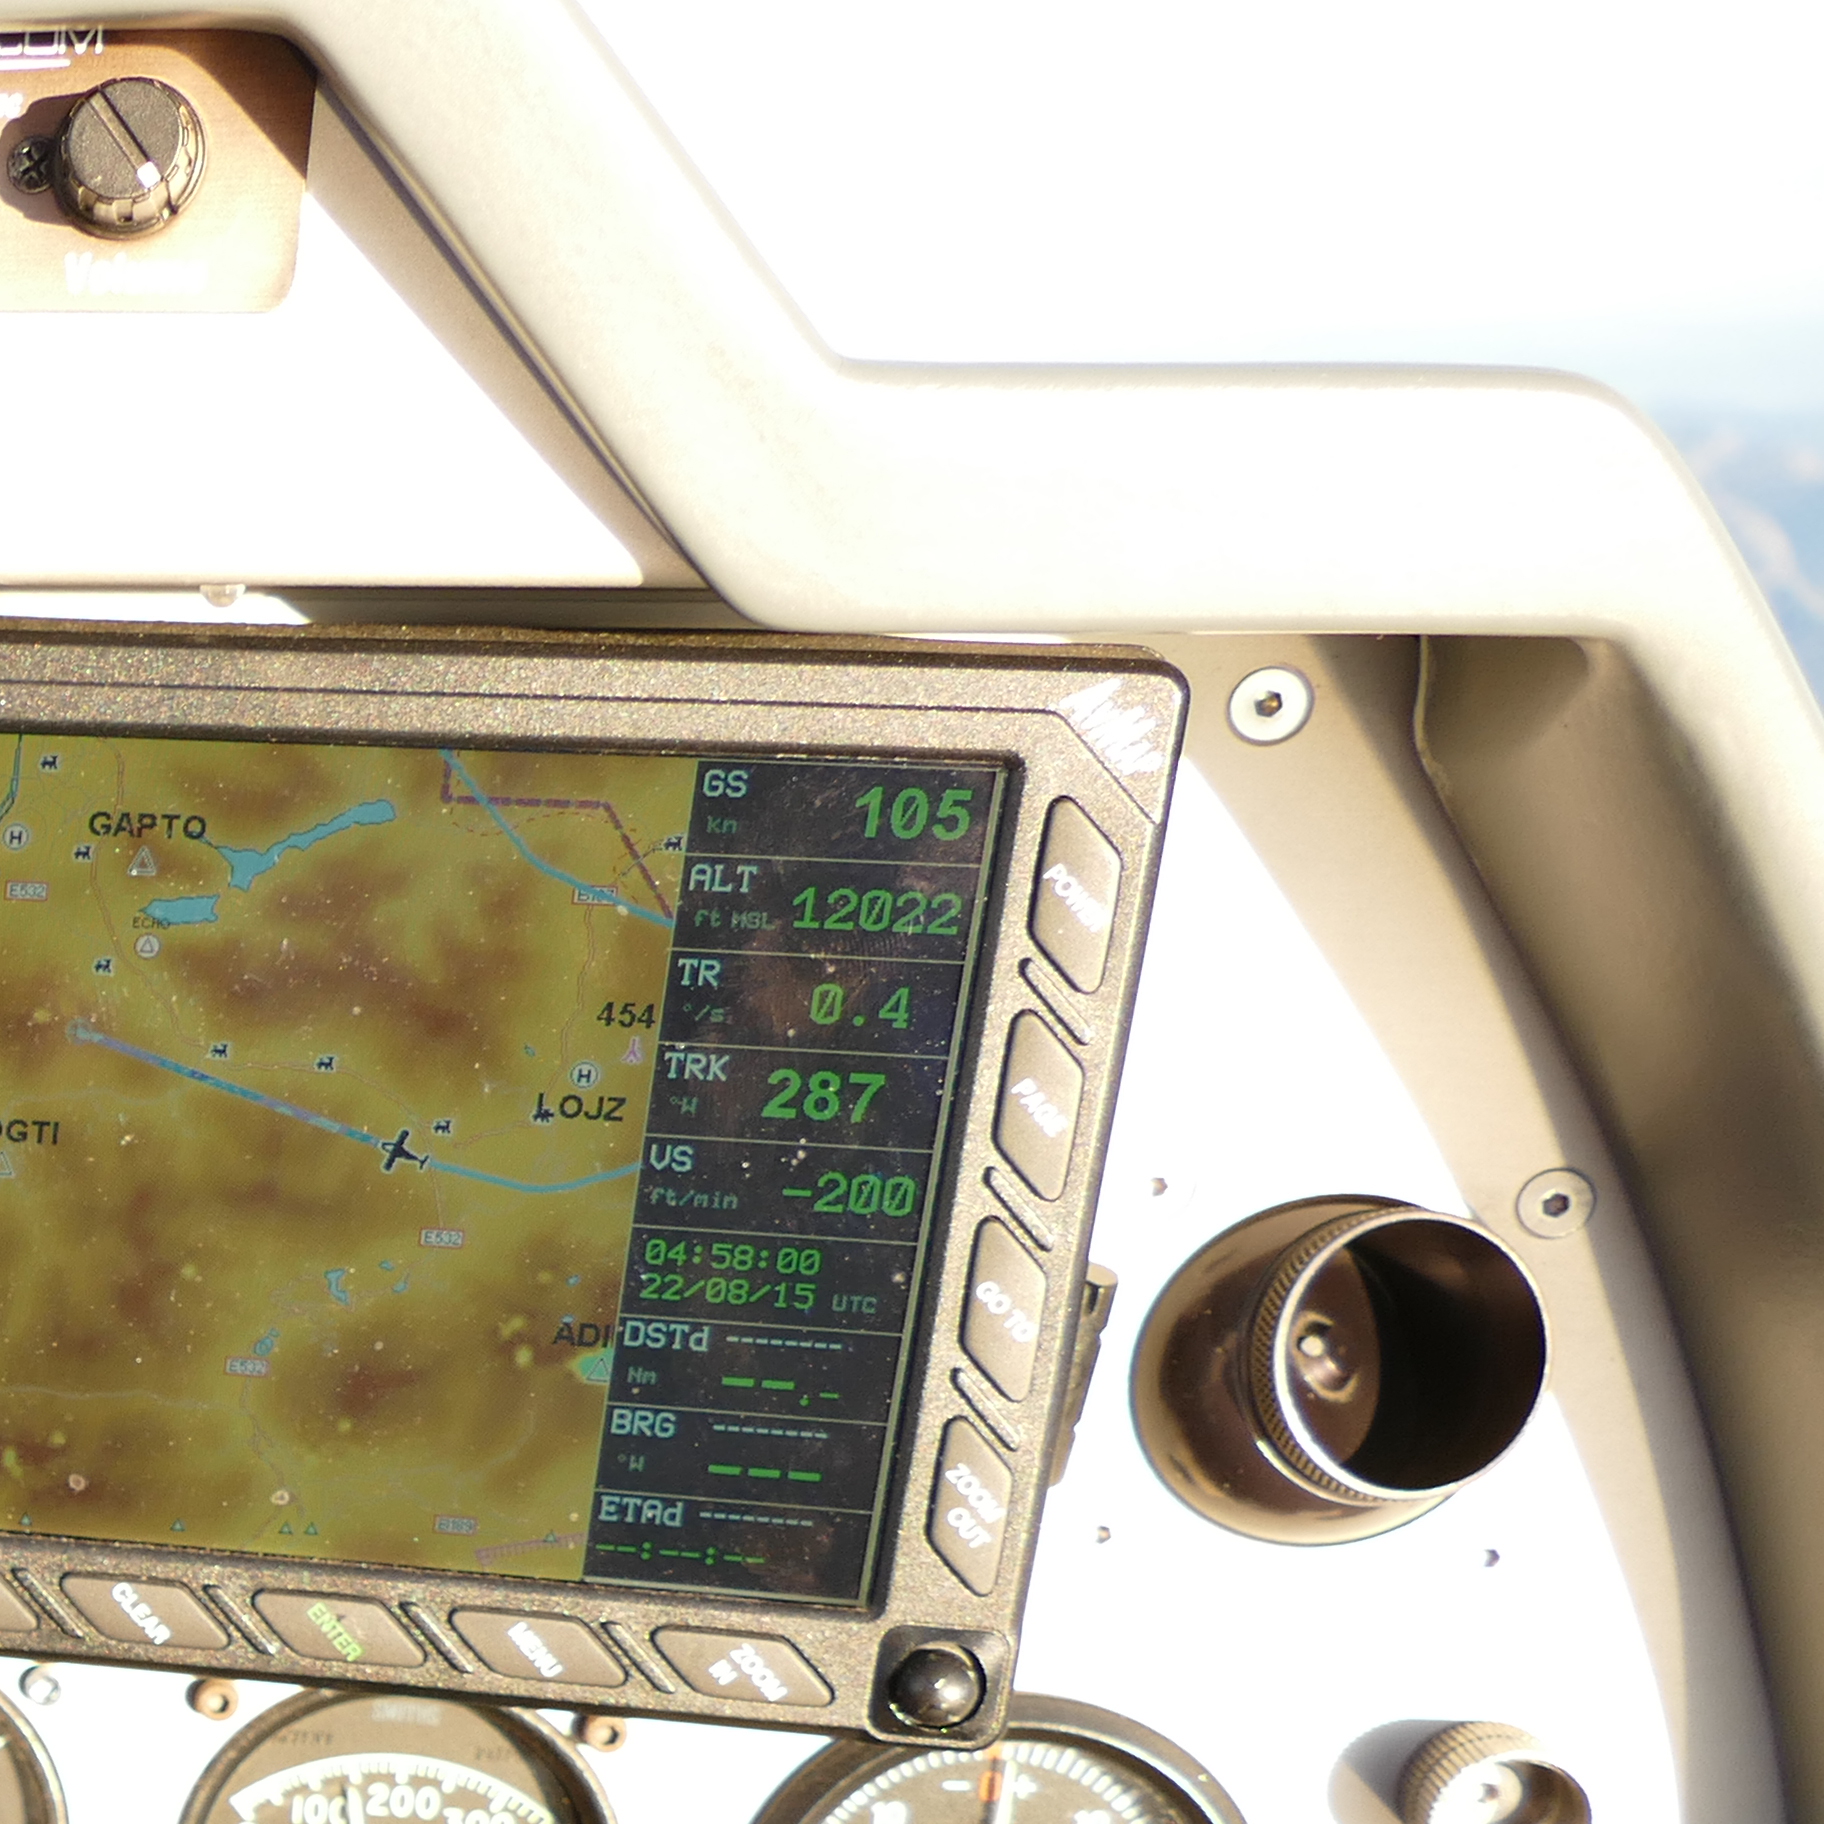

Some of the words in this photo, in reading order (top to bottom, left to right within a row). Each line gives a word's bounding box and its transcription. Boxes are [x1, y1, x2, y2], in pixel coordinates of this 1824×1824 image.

[702, 769, 750, 798] GS
[88, 811, 208, 841] GAPTO
[855, 786, 974, 842] 105
[688, 865, 759, 895] ALT
[792, 886, 963, 937] 12022
[678, 958, 723, 988] TR
[665, 1051, 731, 1083] TRK
[536, 1091, 628, 1123] LOJZ
[760, 1067, 888, 1125] 287
[649, 1144, 694, 1173] VS
[644, 1238, 822, 1275] 04:58:00
[639, 1273, 817, 1311] 22/08/15
[622, 1320, 711, 1353] DSTd
[610, 1408, 677, 1440] BRG
[598, 1496, 684, 1529] ETAd
[111, 1581, 174, 1646] CLEAR
[305, 1601, 367, 1663] ENTER
[506, 1621, 565, 1678] MENU
[365, 1782, 443, 1820] 200
